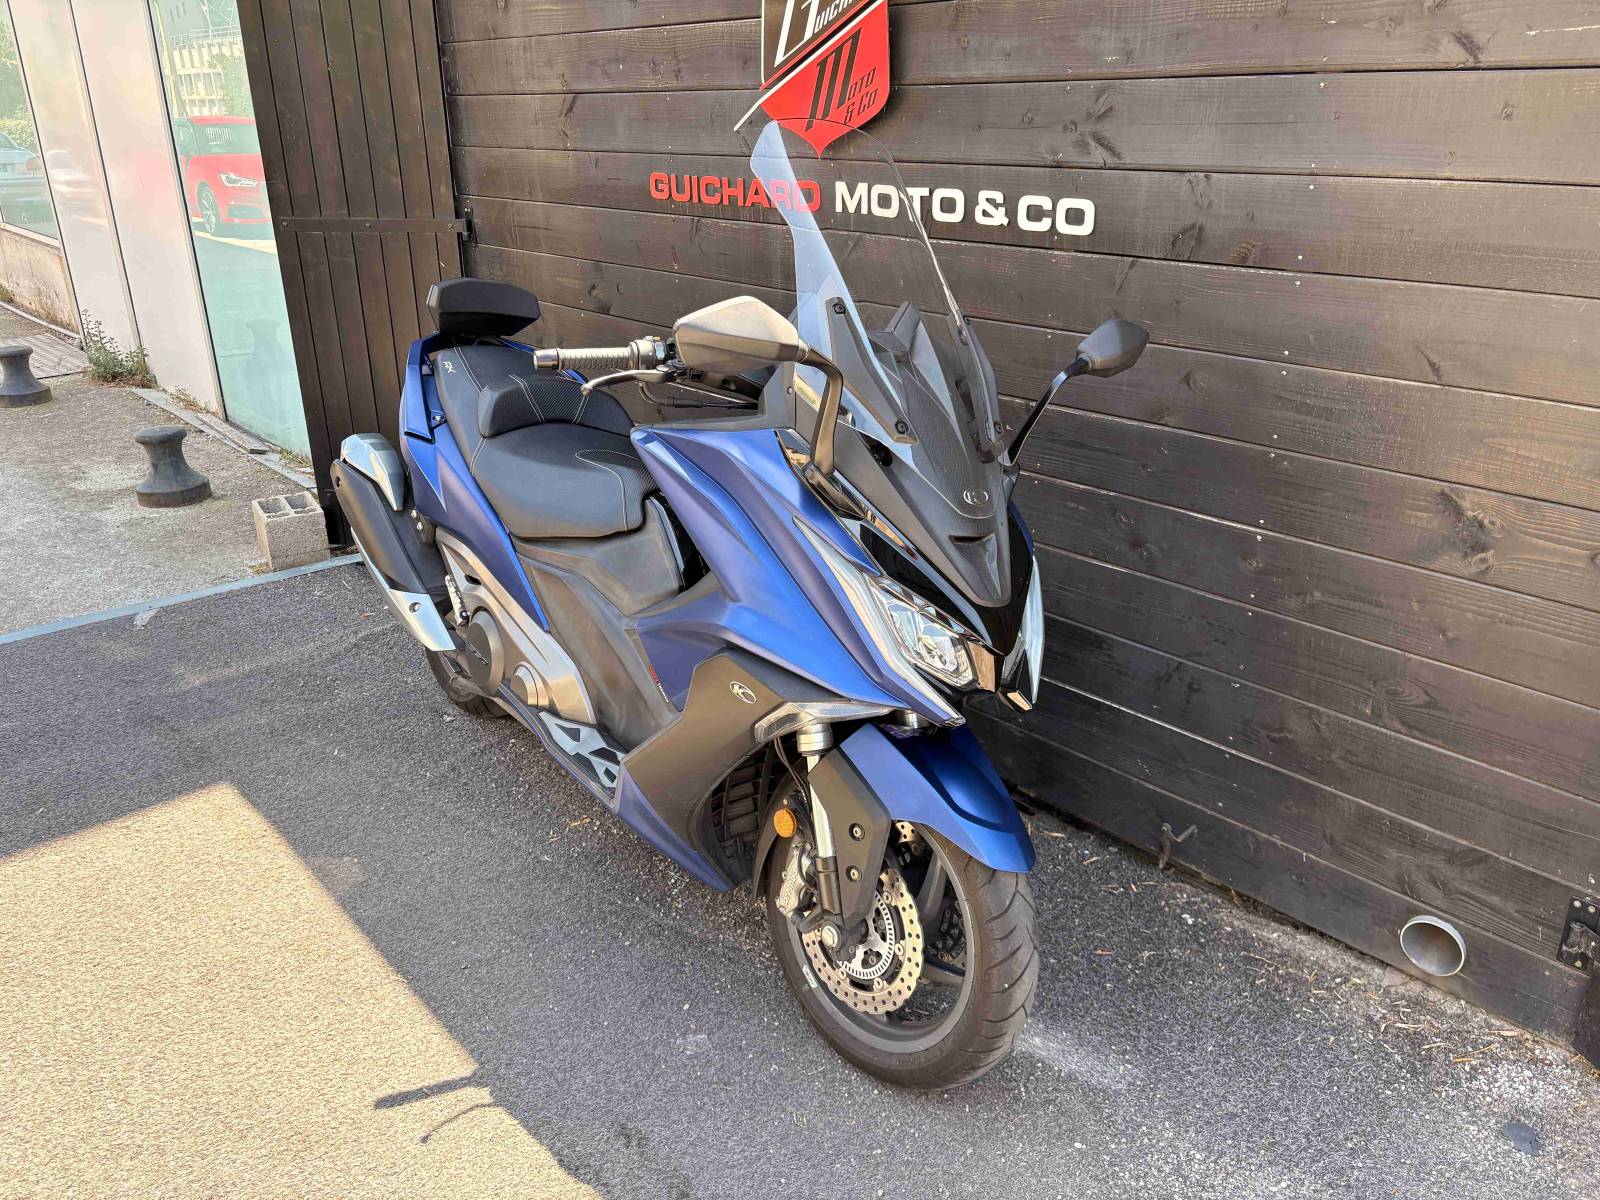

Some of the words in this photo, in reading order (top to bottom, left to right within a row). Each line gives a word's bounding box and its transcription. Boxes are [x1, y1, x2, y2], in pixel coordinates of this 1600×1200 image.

[650, 171, 821, 212] GUICHARD
[835, 181, 965, 223] MOTO
[974, 190, 1009, 227] &
[1017, 195, 1095, 236] CO
